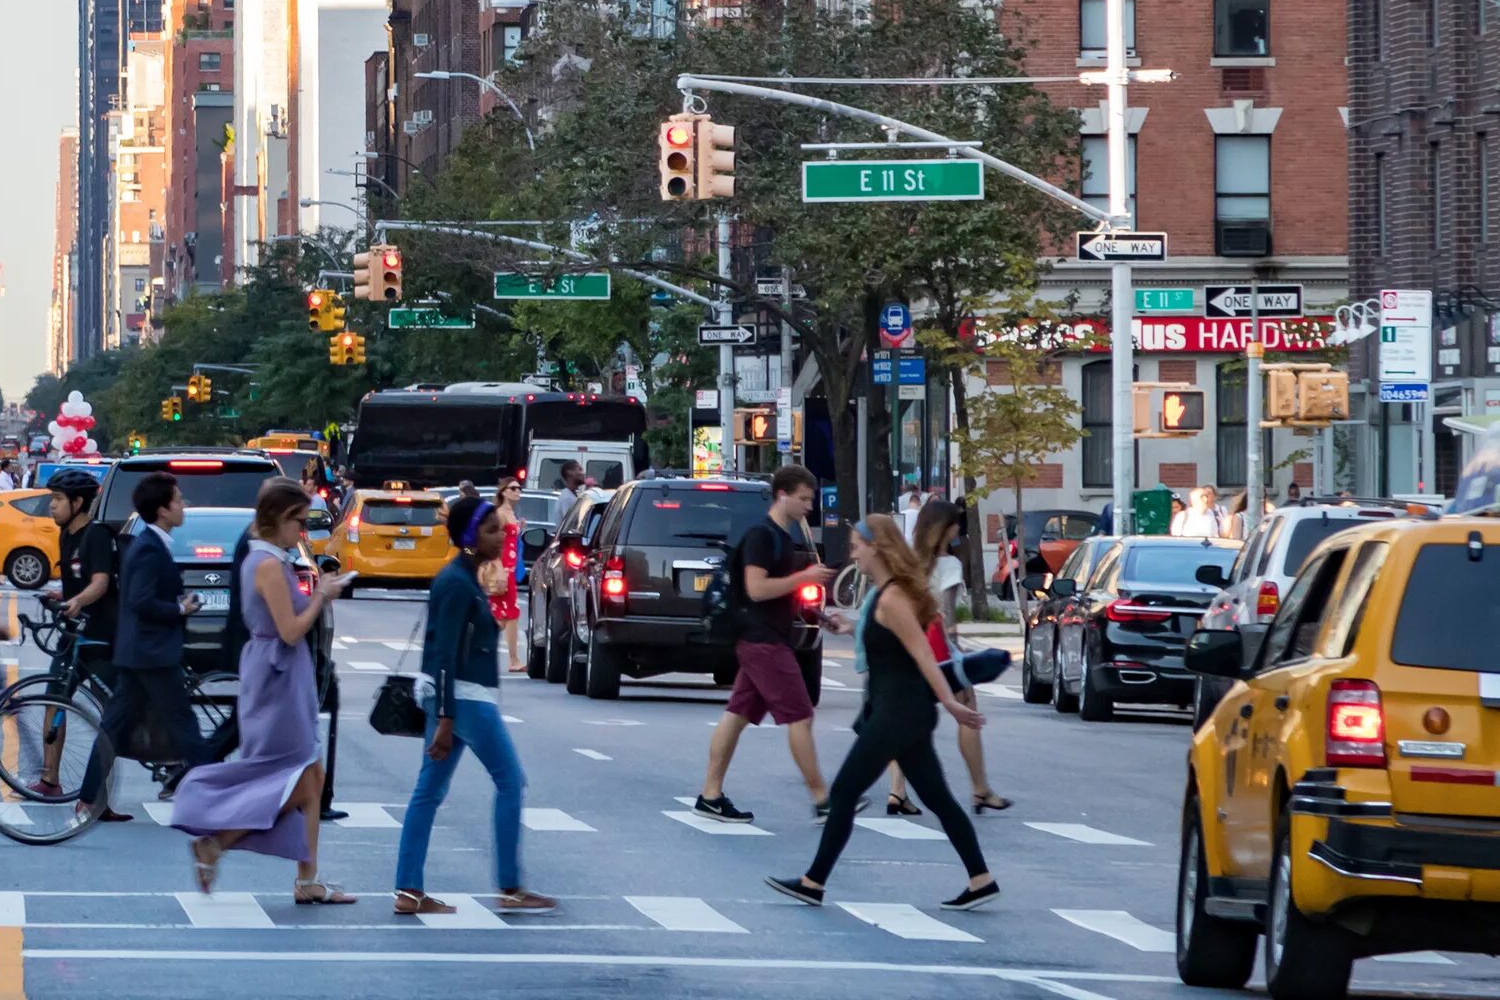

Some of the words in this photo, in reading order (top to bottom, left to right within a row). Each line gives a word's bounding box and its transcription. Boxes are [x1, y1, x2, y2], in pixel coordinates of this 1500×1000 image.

[860, 169, 873, 192] E
[882, 169, 895, 192] 11
[903, 168, 926, 192] St
[1094, 242, 1118, 254] ONE
[1130, 242, 1156, 254] WAY
[560, 278, 575, 294] St
[1142, 291, 1151, 308] E
[1159, 291, 1169, 308] 11
[1223, 296, 1251, 309] ONE
[1263, 295, 1292, 308] WAY
[706, 330, 724, 340] ONE
[730, 330, 749, 339] WAY
[828, 494, 836, 507] P
